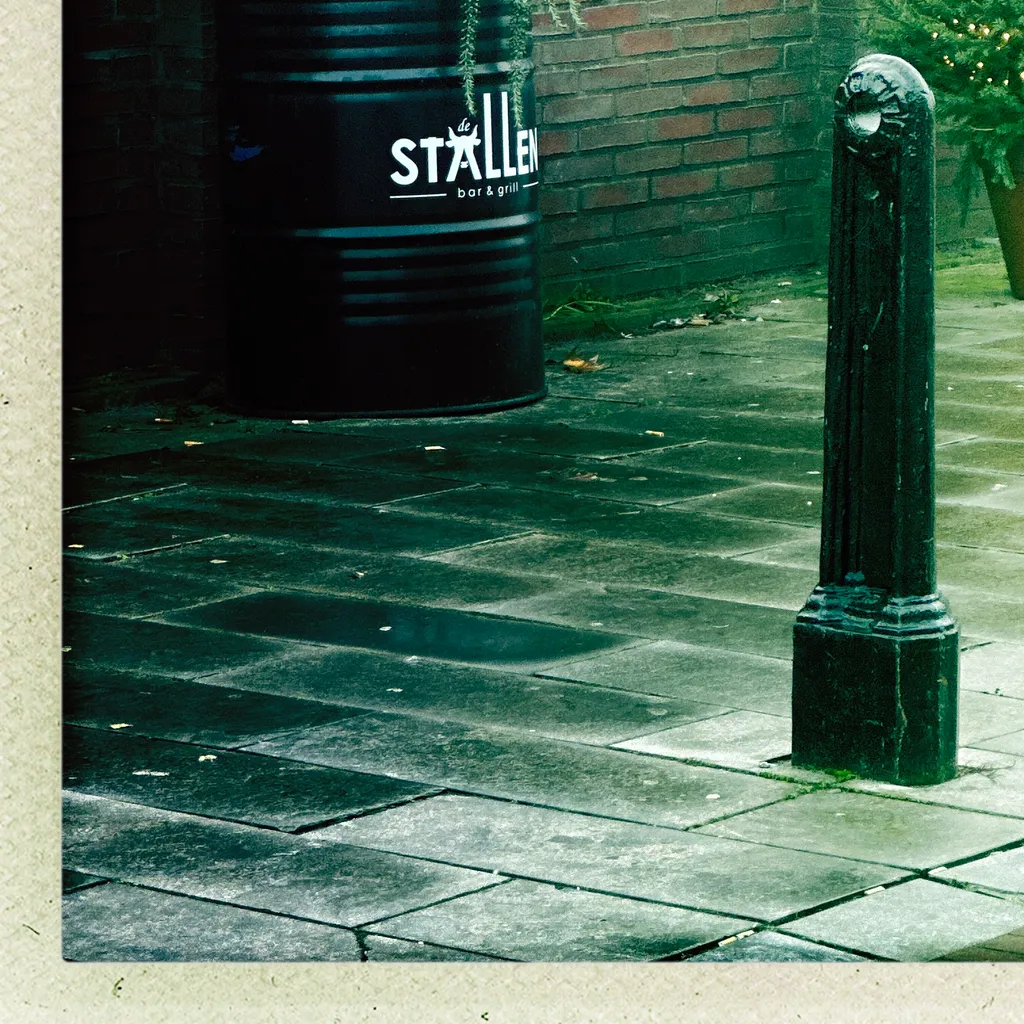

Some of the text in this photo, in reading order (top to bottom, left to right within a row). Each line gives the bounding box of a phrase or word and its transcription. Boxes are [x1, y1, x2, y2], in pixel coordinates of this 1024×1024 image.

[457, 117, 471, 132] de
[390, 91, 539, 186] STALLEN
[457, 181, 519, 198] bar & grill
